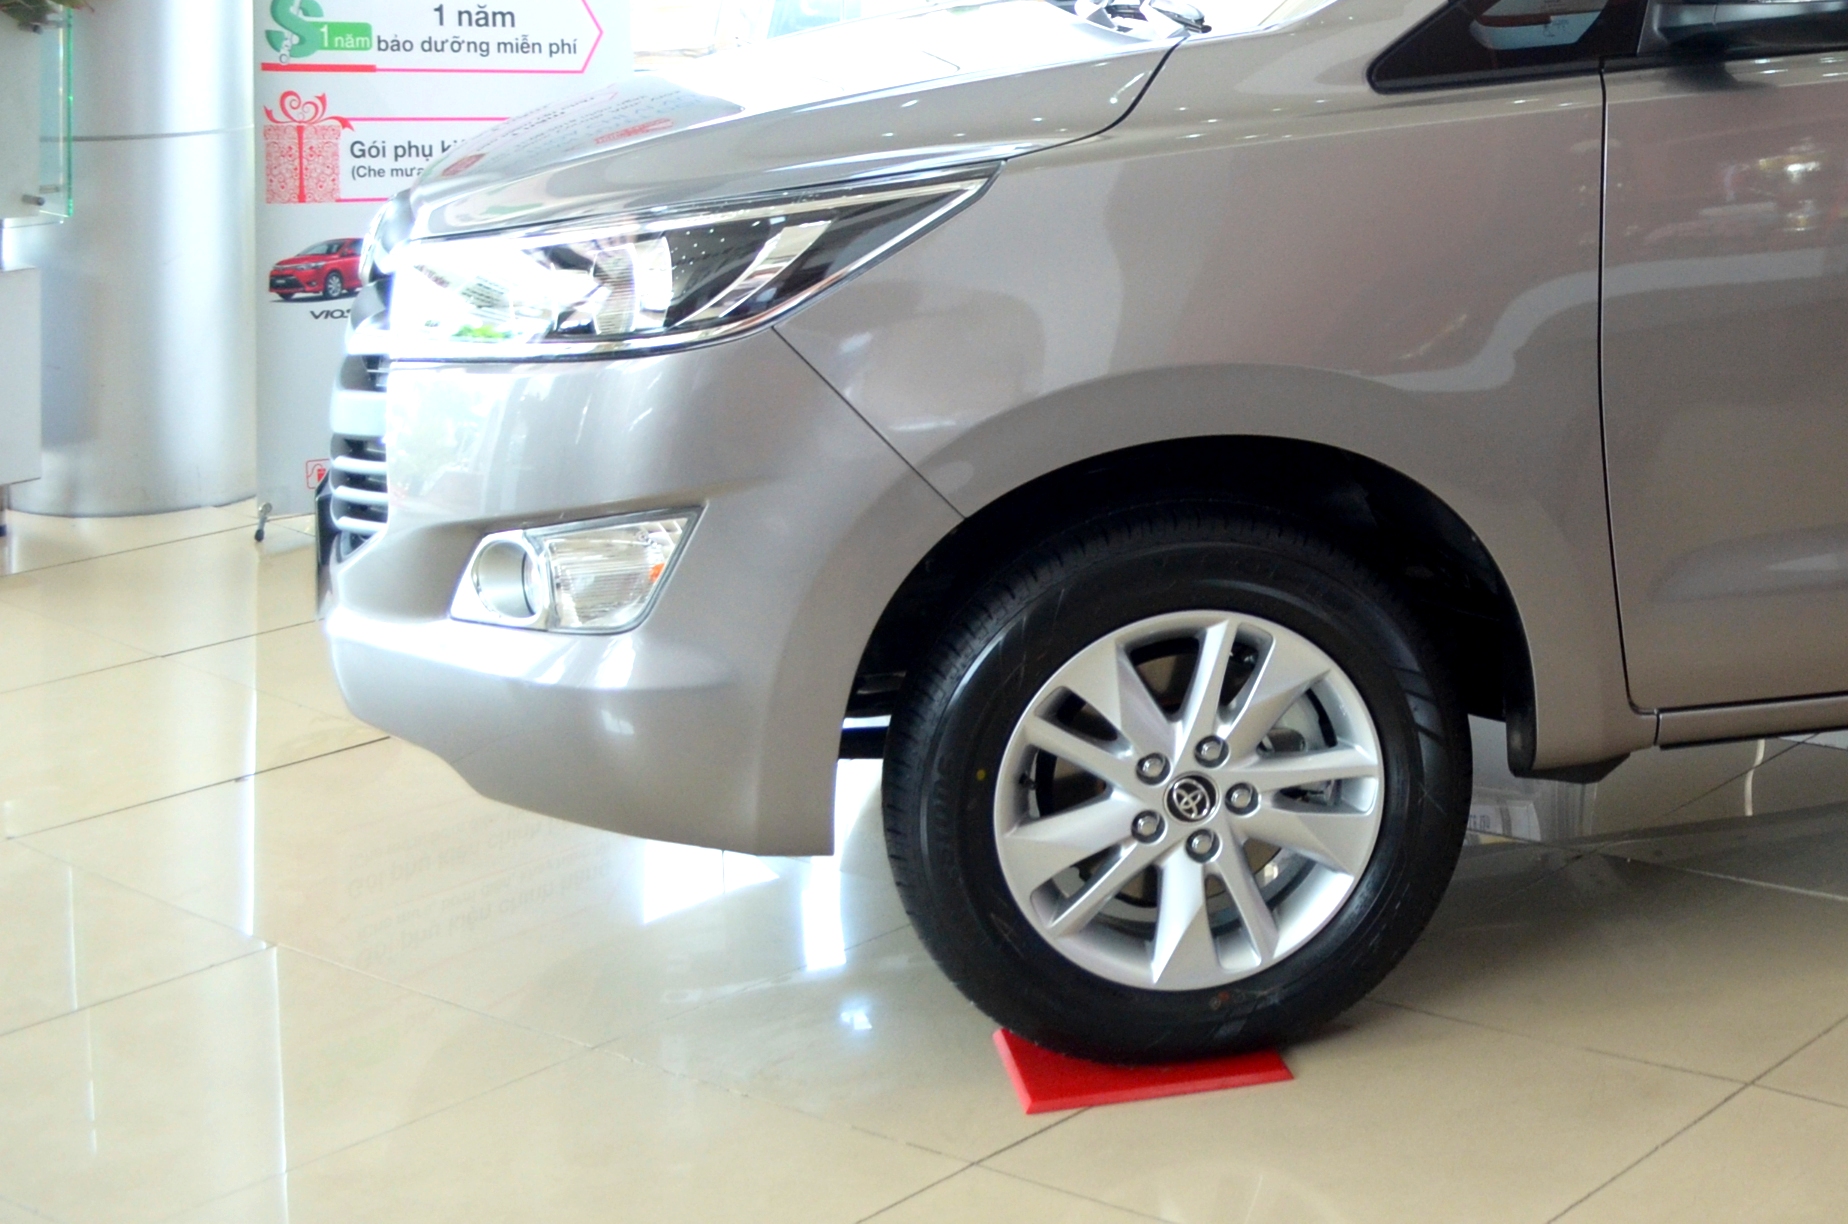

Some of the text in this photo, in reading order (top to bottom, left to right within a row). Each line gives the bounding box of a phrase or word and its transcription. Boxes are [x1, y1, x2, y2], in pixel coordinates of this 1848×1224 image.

[433, 4, 516, 28] 1 năm
[319, 24, 370, 49] 1 năm
[376, 33, 578, 59] bảo dưỡng miễn phí
[350, 140, 386, 158] Gói
[394, 140, 433, 162] phụ
[351, 165, 386, 181] (Che
